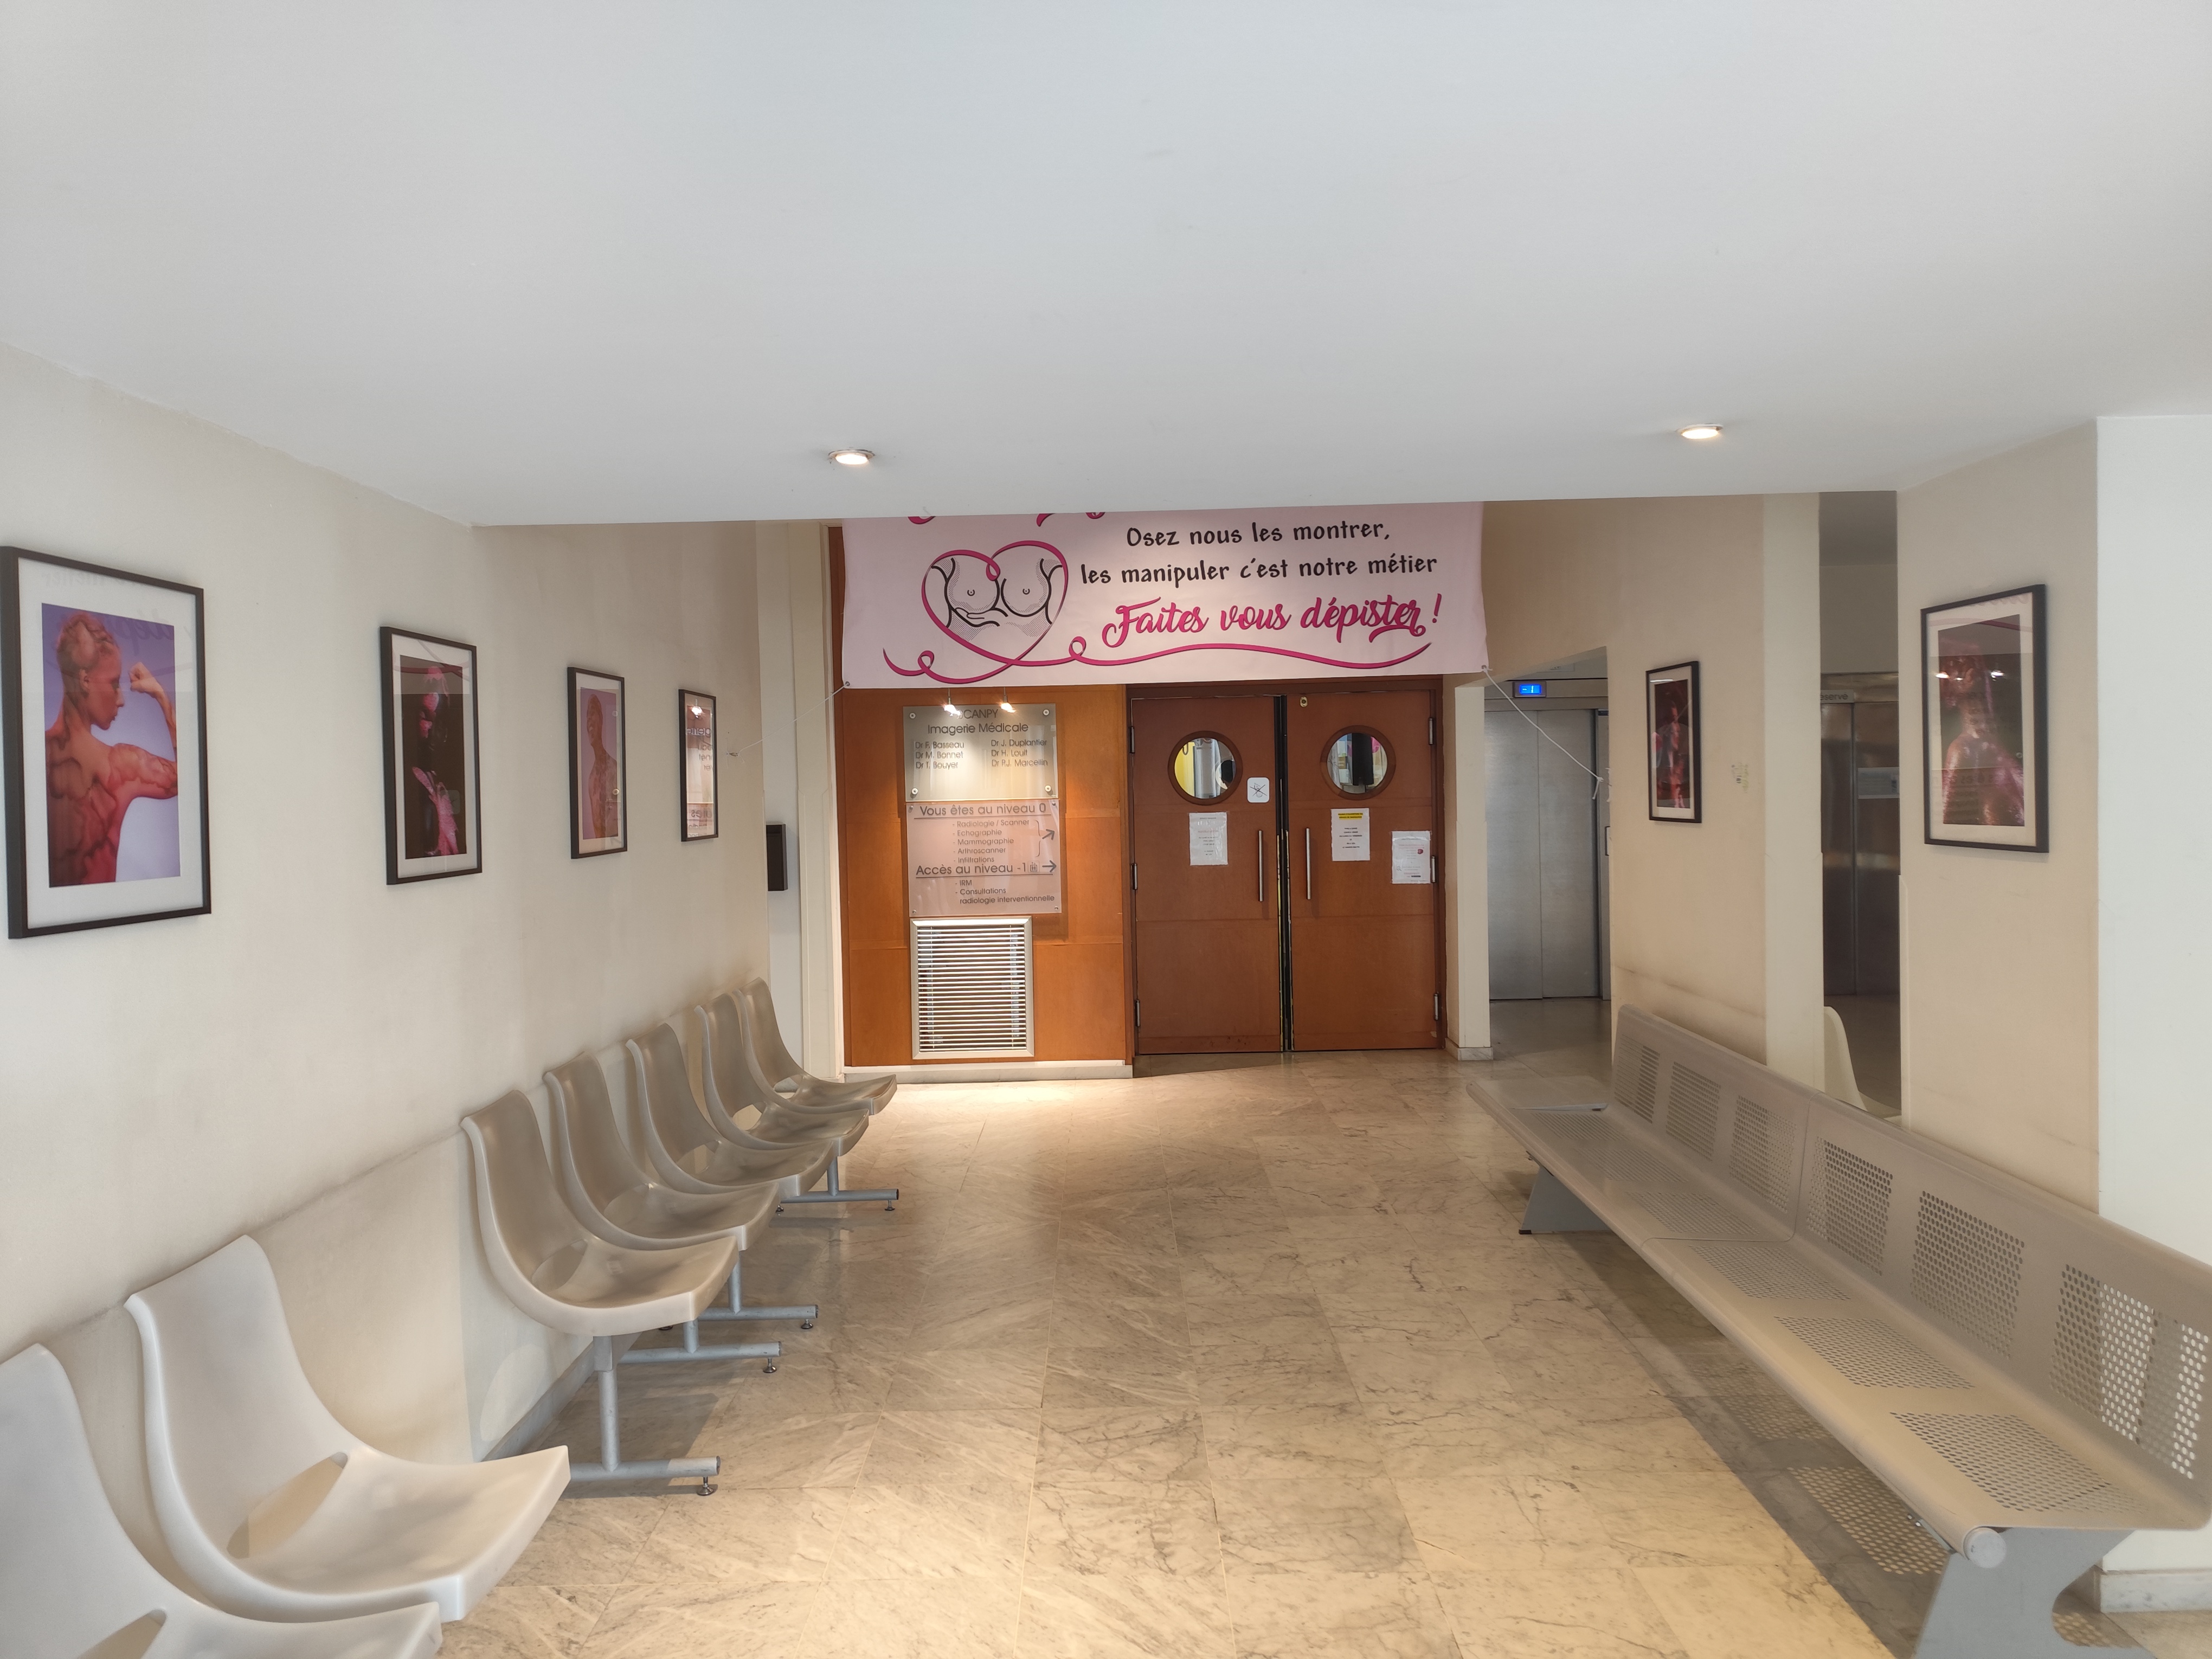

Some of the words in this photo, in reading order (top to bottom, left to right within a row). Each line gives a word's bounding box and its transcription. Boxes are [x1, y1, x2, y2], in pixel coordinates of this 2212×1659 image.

[1127, 527, 1180, 546] Osez
[1189, 529, 1242, 544] nous
[1252, 522, 1283, 542] les
[1293, 520, 1390, 541] montrer,
[1081, 564, 1111, 584] les
[1121, 560, 1230, 589] manipuler
[1240, 557, 1288, 578] c'est
[1299, 557, 1358, 577] notre
[1368, 553, 1437, 574] métier
[1102, 596, 1210, 648] Faites
[1220, 603, 1292, 631] vous
[1300, 594, 1426, 644] dépister
[928, 723, 976, 736] Imagerie
[978, 722, 1029, 732] Médicale
[1009, 739, 1047, 748] Duplantier
[925, 751, 935, 759] M.
[937, 750, 963, 759] Bonnet
[933, 761, 959, 770] Bouyer
[992, 759, 999, 767] Dr
[1014, 758, 1048, 767] Marcellin
[920, 805, 947, 816] Vous
[950, 804, 974, 816] êtes
[978, 806, 993, 814] au
[996, 803, 1035, 814] niveau
[1039, 802, 1046, 813] 0
[956, 820, 994, 828] Radiologie
[957, 838, 1014, 846] Mammographie
[916, 864, 952, 876] Accès
[955, 866, 970, 874] au
[974, 864, 1013, 873] niveau
